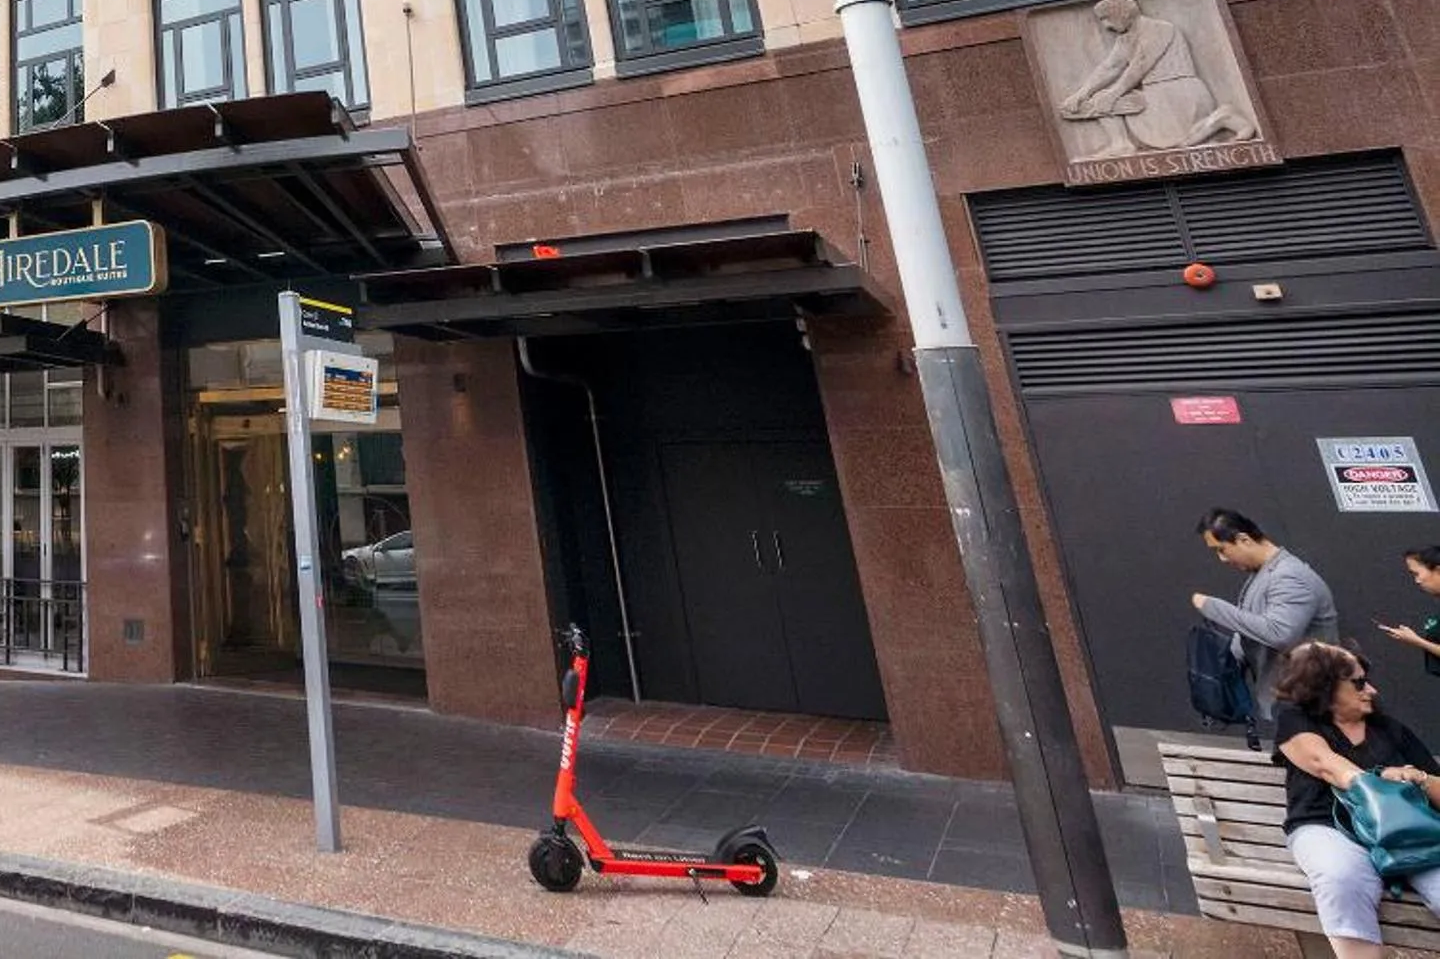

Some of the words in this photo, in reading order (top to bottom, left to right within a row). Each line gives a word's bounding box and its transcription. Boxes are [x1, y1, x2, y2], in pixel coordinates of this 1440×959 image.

[1066, 156, 1135, 183] UNION
[1141, 157, 1159, 176] IS
[1166, 145, 1277, 173] STRENGTH
[1370, 484, 1418, 493] VOLTAGE
